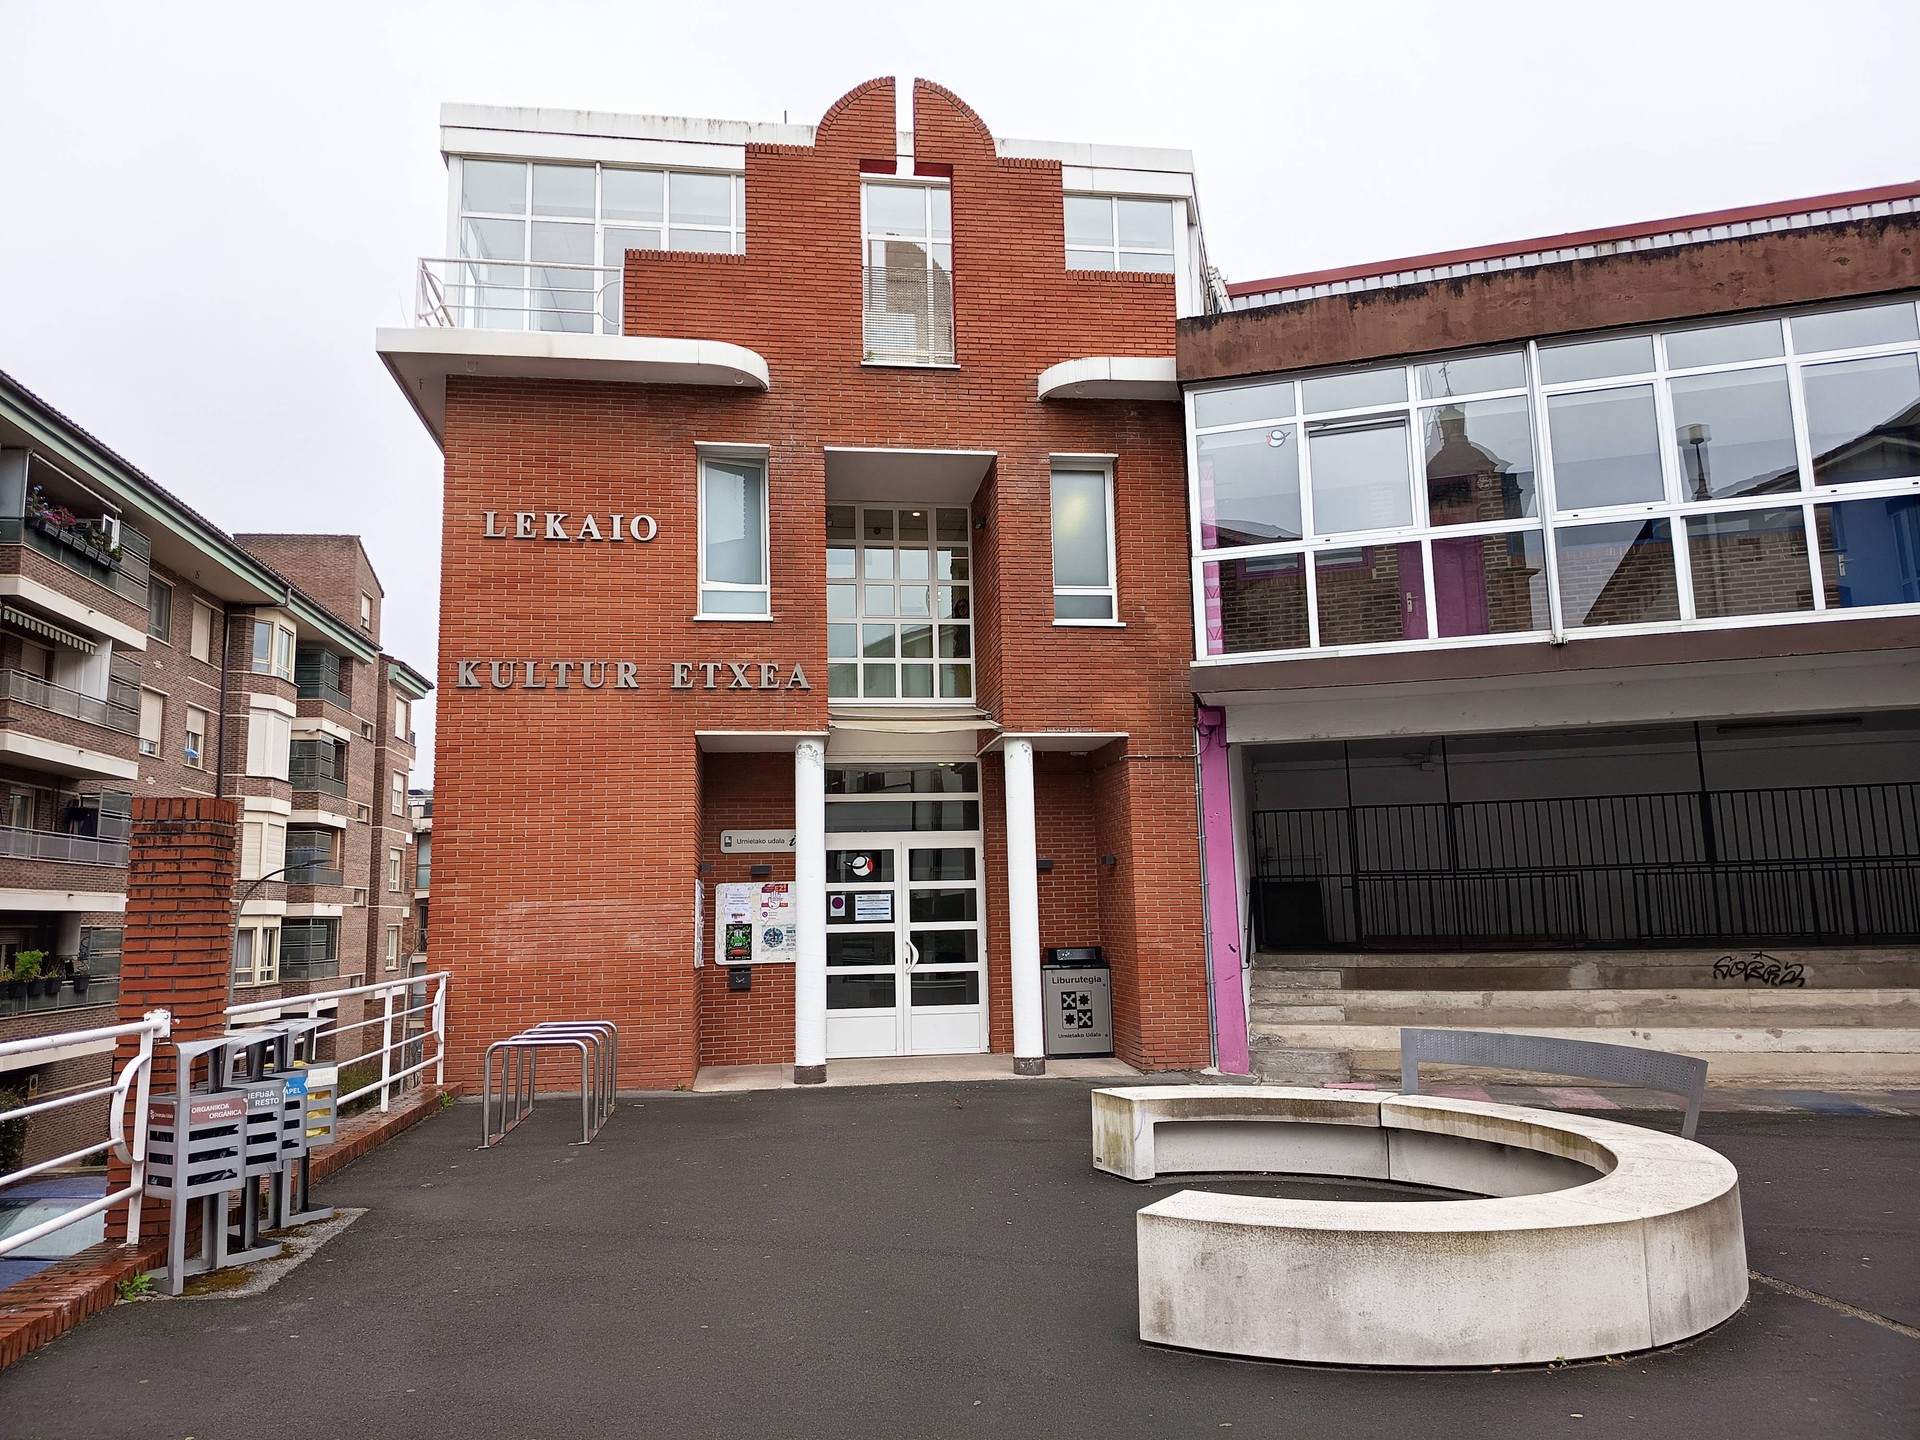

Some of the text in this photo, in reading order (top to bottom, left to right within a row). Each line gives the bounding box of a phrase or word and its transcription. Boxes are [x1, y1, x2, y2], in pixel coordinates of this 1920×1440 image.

[483, 510, 658, 542] LEKAIO
[455, 660, 811, 690] KULTUR ETXEA
[1051, 975, 1102, 985] Liburutegia
[285, 1087, 302, 1095] APEL
[255, 1097, 280, 1107] RESTO
[191, 1103, 230, 1114] ORGANIKOA
[208, 1109, 242, 1119] ORGÁNICA
